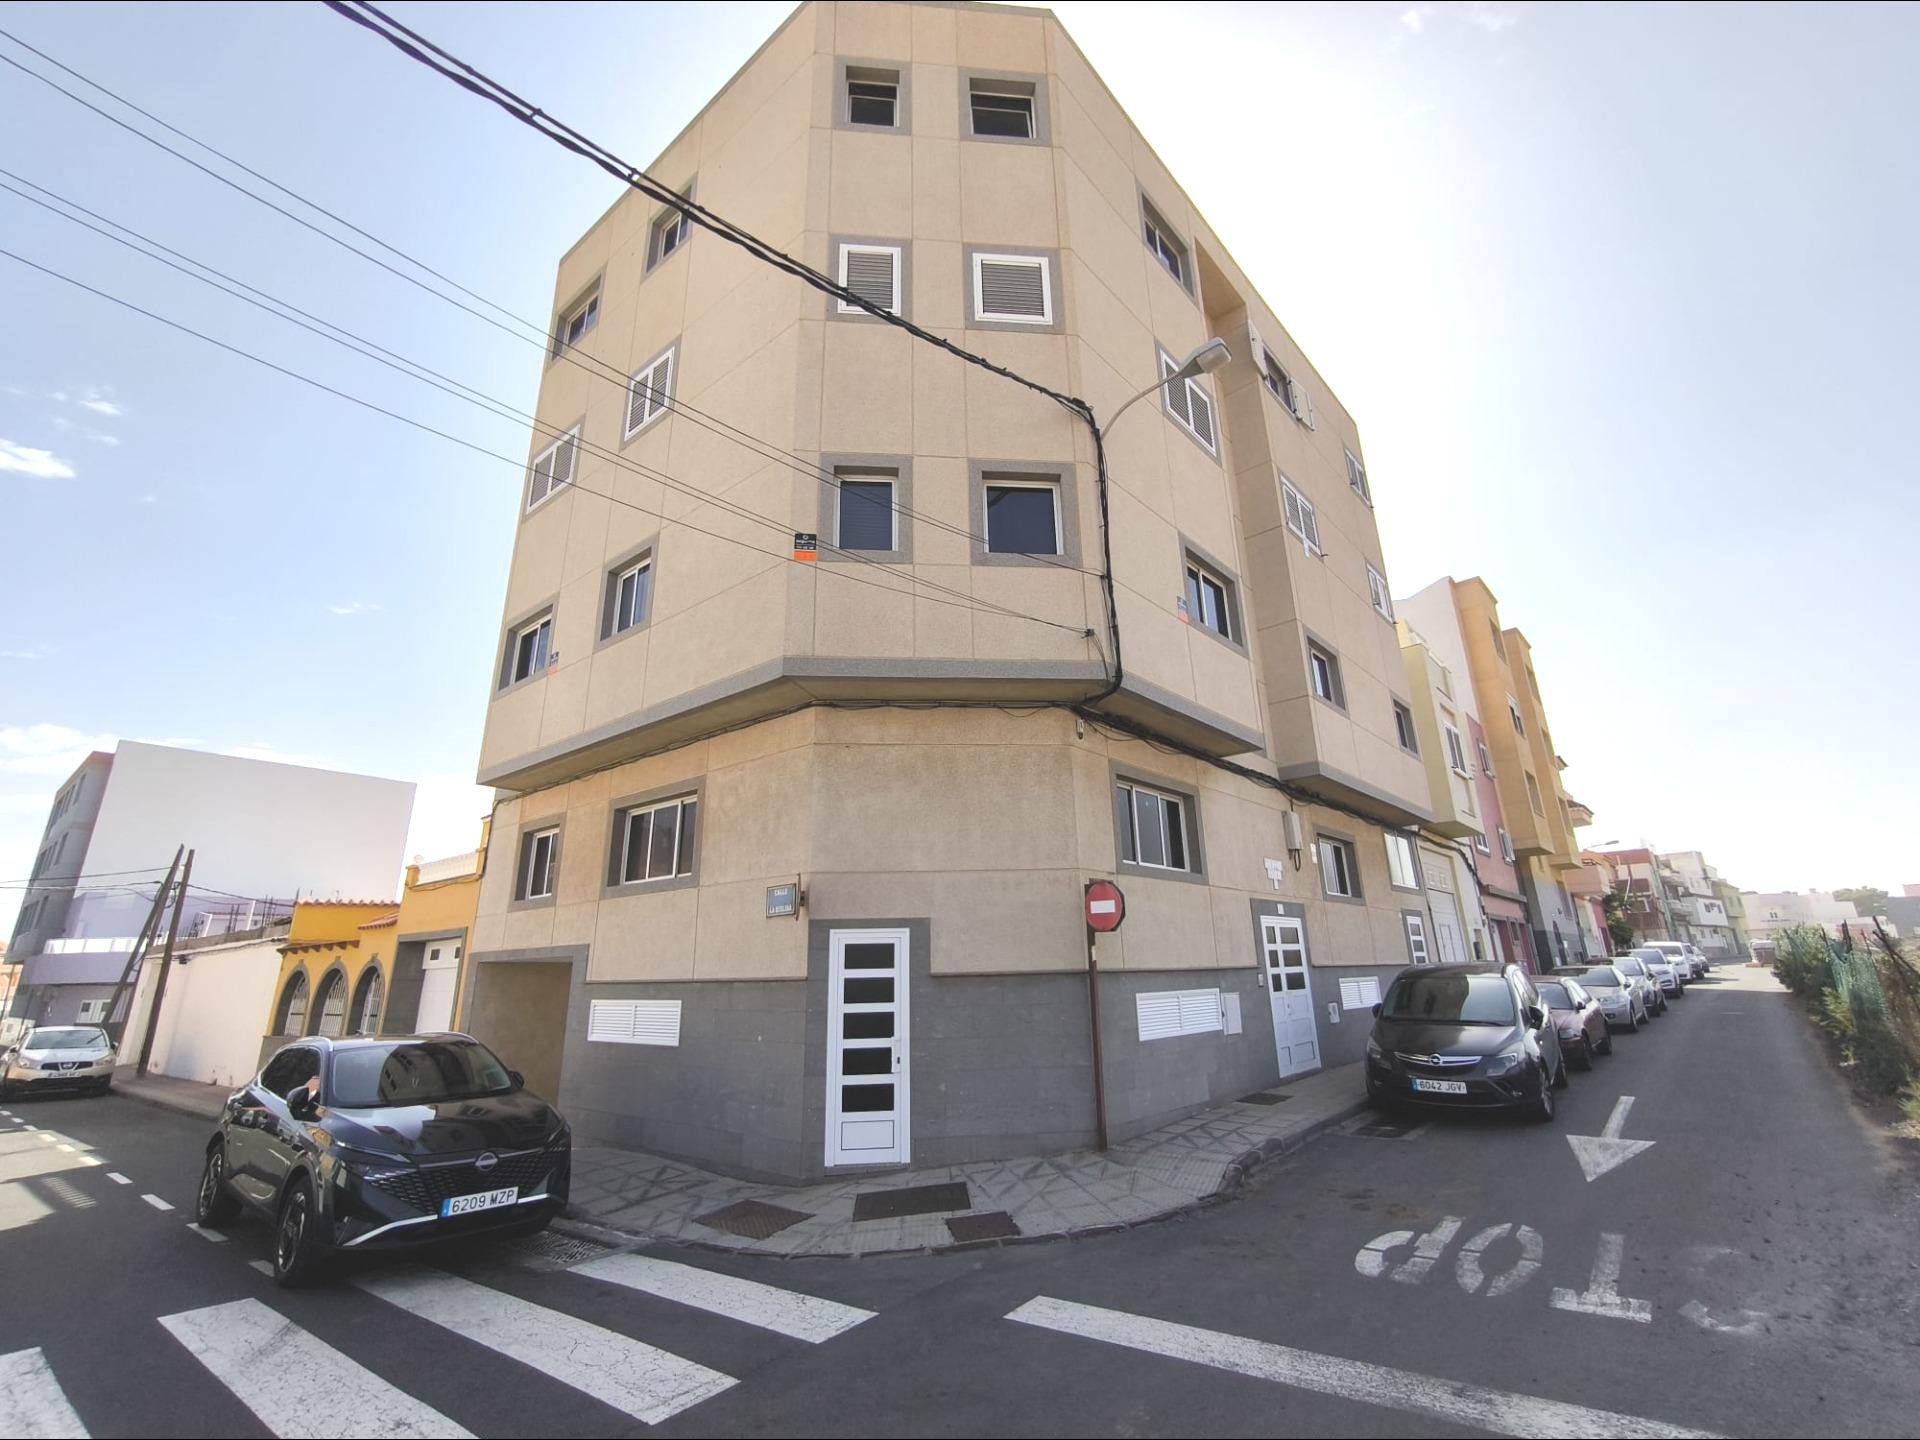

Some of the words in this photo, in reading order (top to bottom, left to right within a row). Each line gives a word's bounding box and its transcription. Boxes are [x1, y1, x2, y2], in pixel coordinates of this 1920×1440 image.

[1419, 1080, 1442, 1091] 6042
[452, 1195, 486, 1213] 6209
[489, 1189, 515, 1206] MZP
